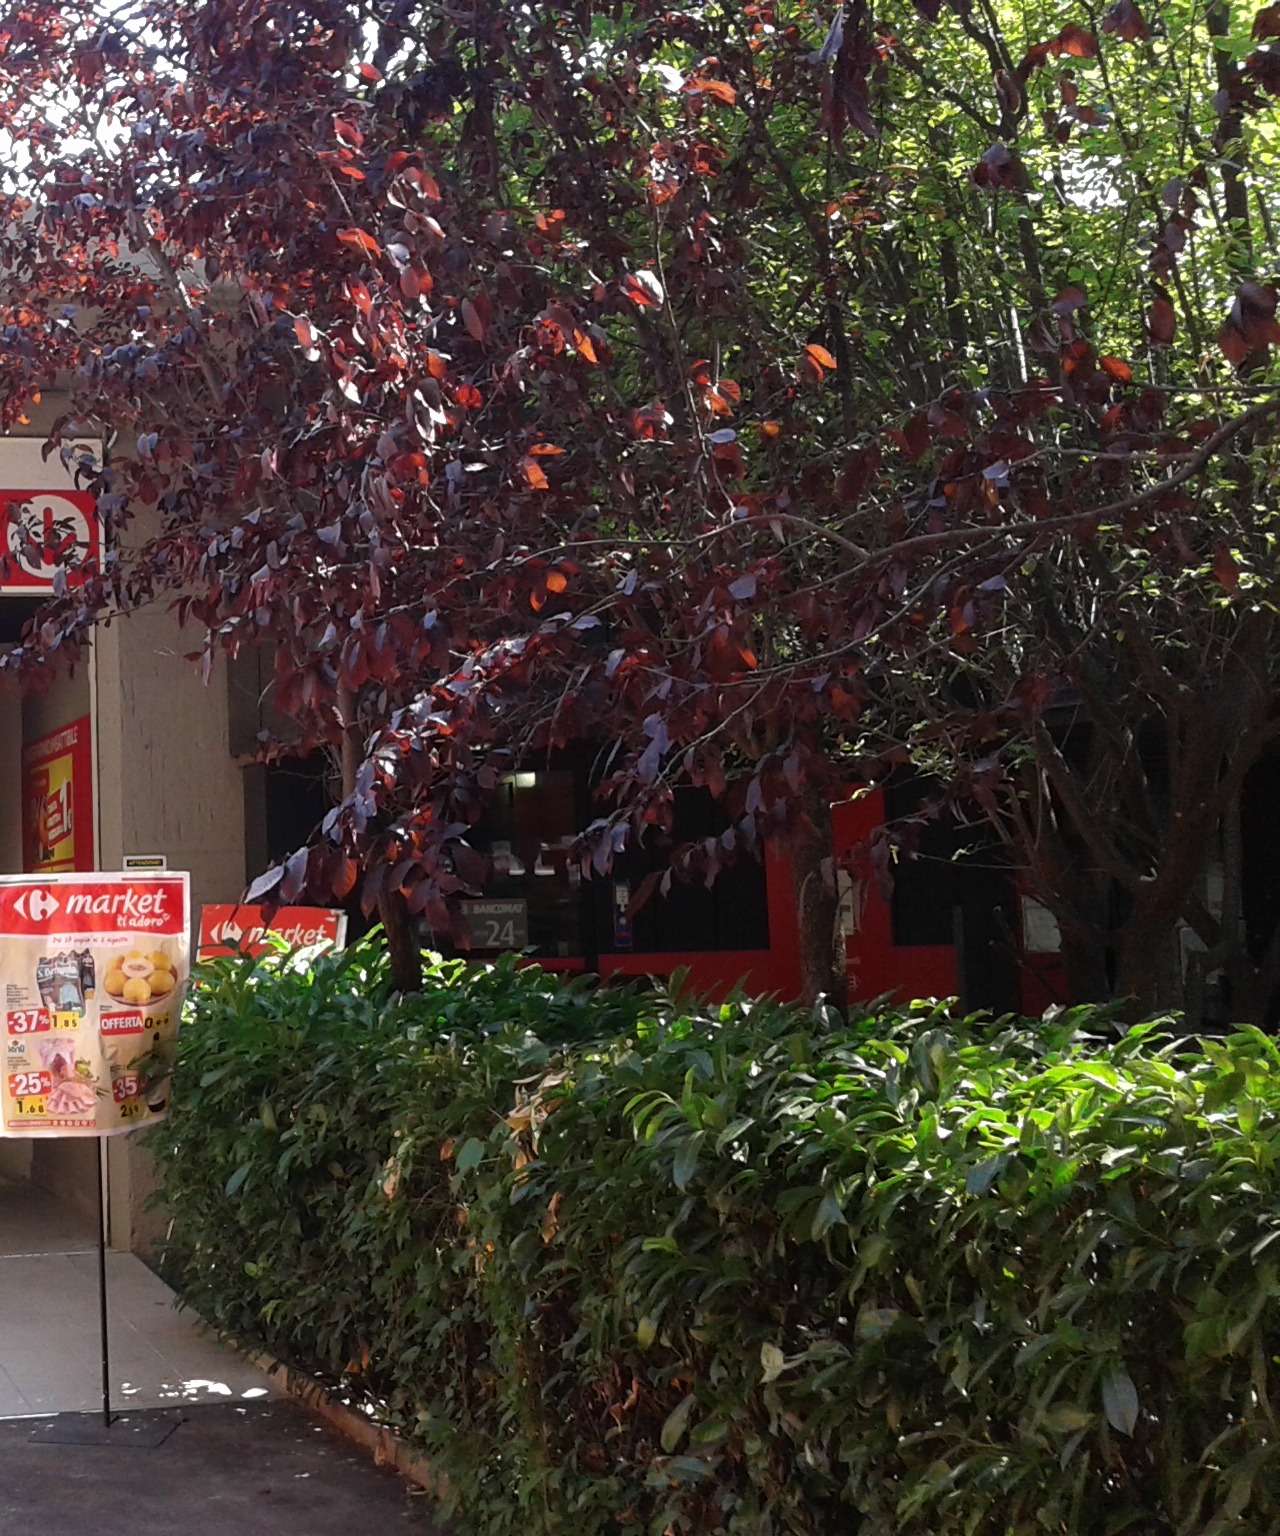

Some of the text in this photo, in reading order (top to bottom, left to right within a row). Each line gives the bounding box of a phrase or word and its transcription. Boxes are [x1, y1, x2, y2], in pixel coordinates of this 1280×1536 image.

[66, 888, 167, 916] market
[473, 904, 523, 914] BANCOMAT
[129, 914, 163, 927] adoro
[486, 920, 515, 946] 24
[8, 1011, 50, 1033] -37%
[101, 1017, 142, 1029] OFFERTA
[9, 1072, 51, 1095] -25%
